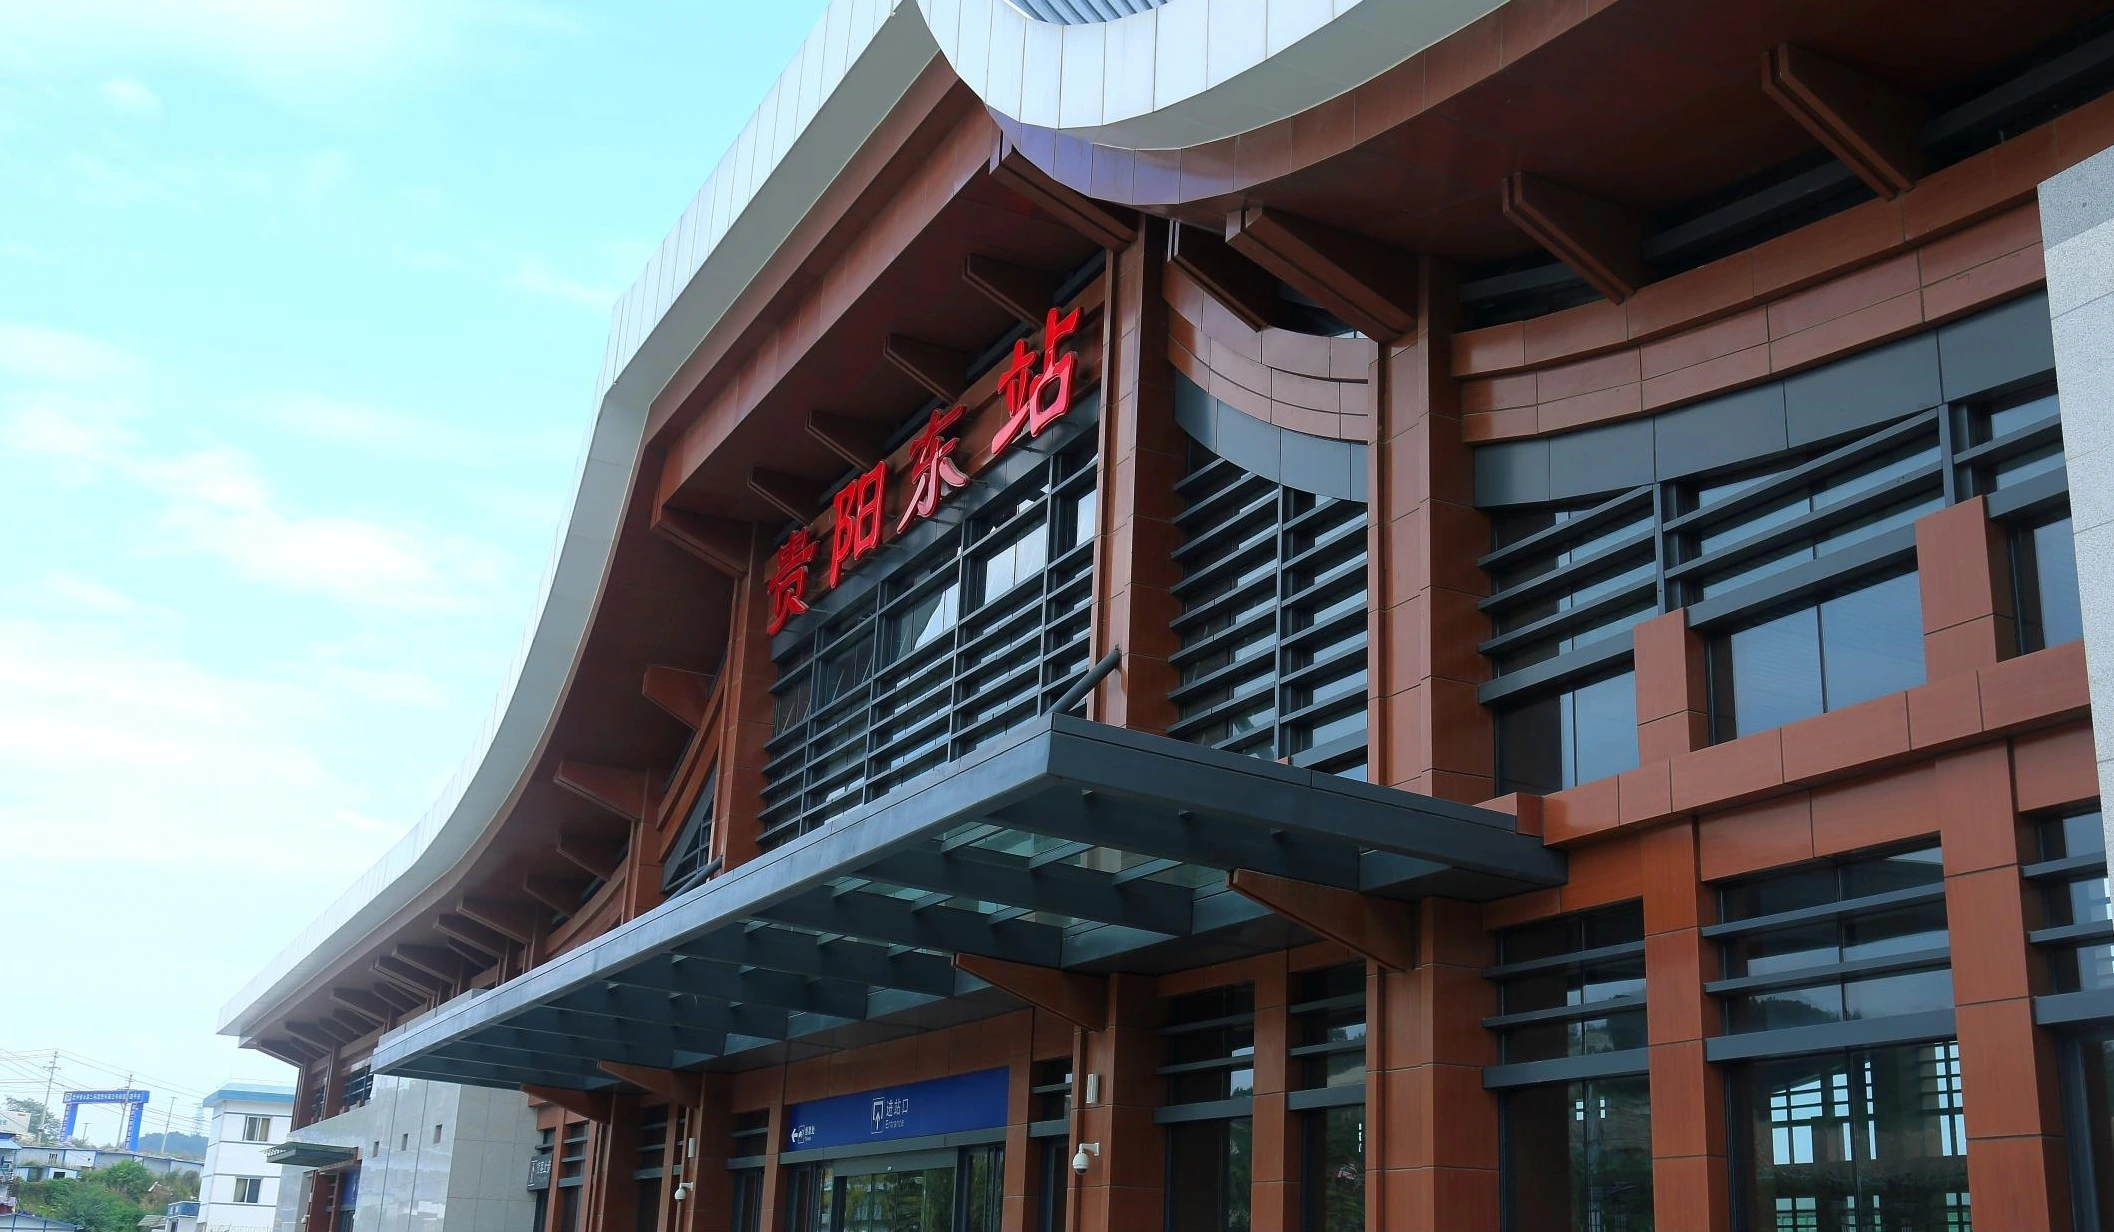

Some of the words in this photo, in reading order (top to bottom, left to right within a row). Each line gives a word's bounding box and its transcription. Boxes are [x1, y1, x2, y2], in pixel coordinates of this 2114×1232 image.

[767, 306, 1085, 636] 贵阳东站
[886, 1098, 909, 1117] 进站口
[885, 1119, 904, 1129] Entrance
